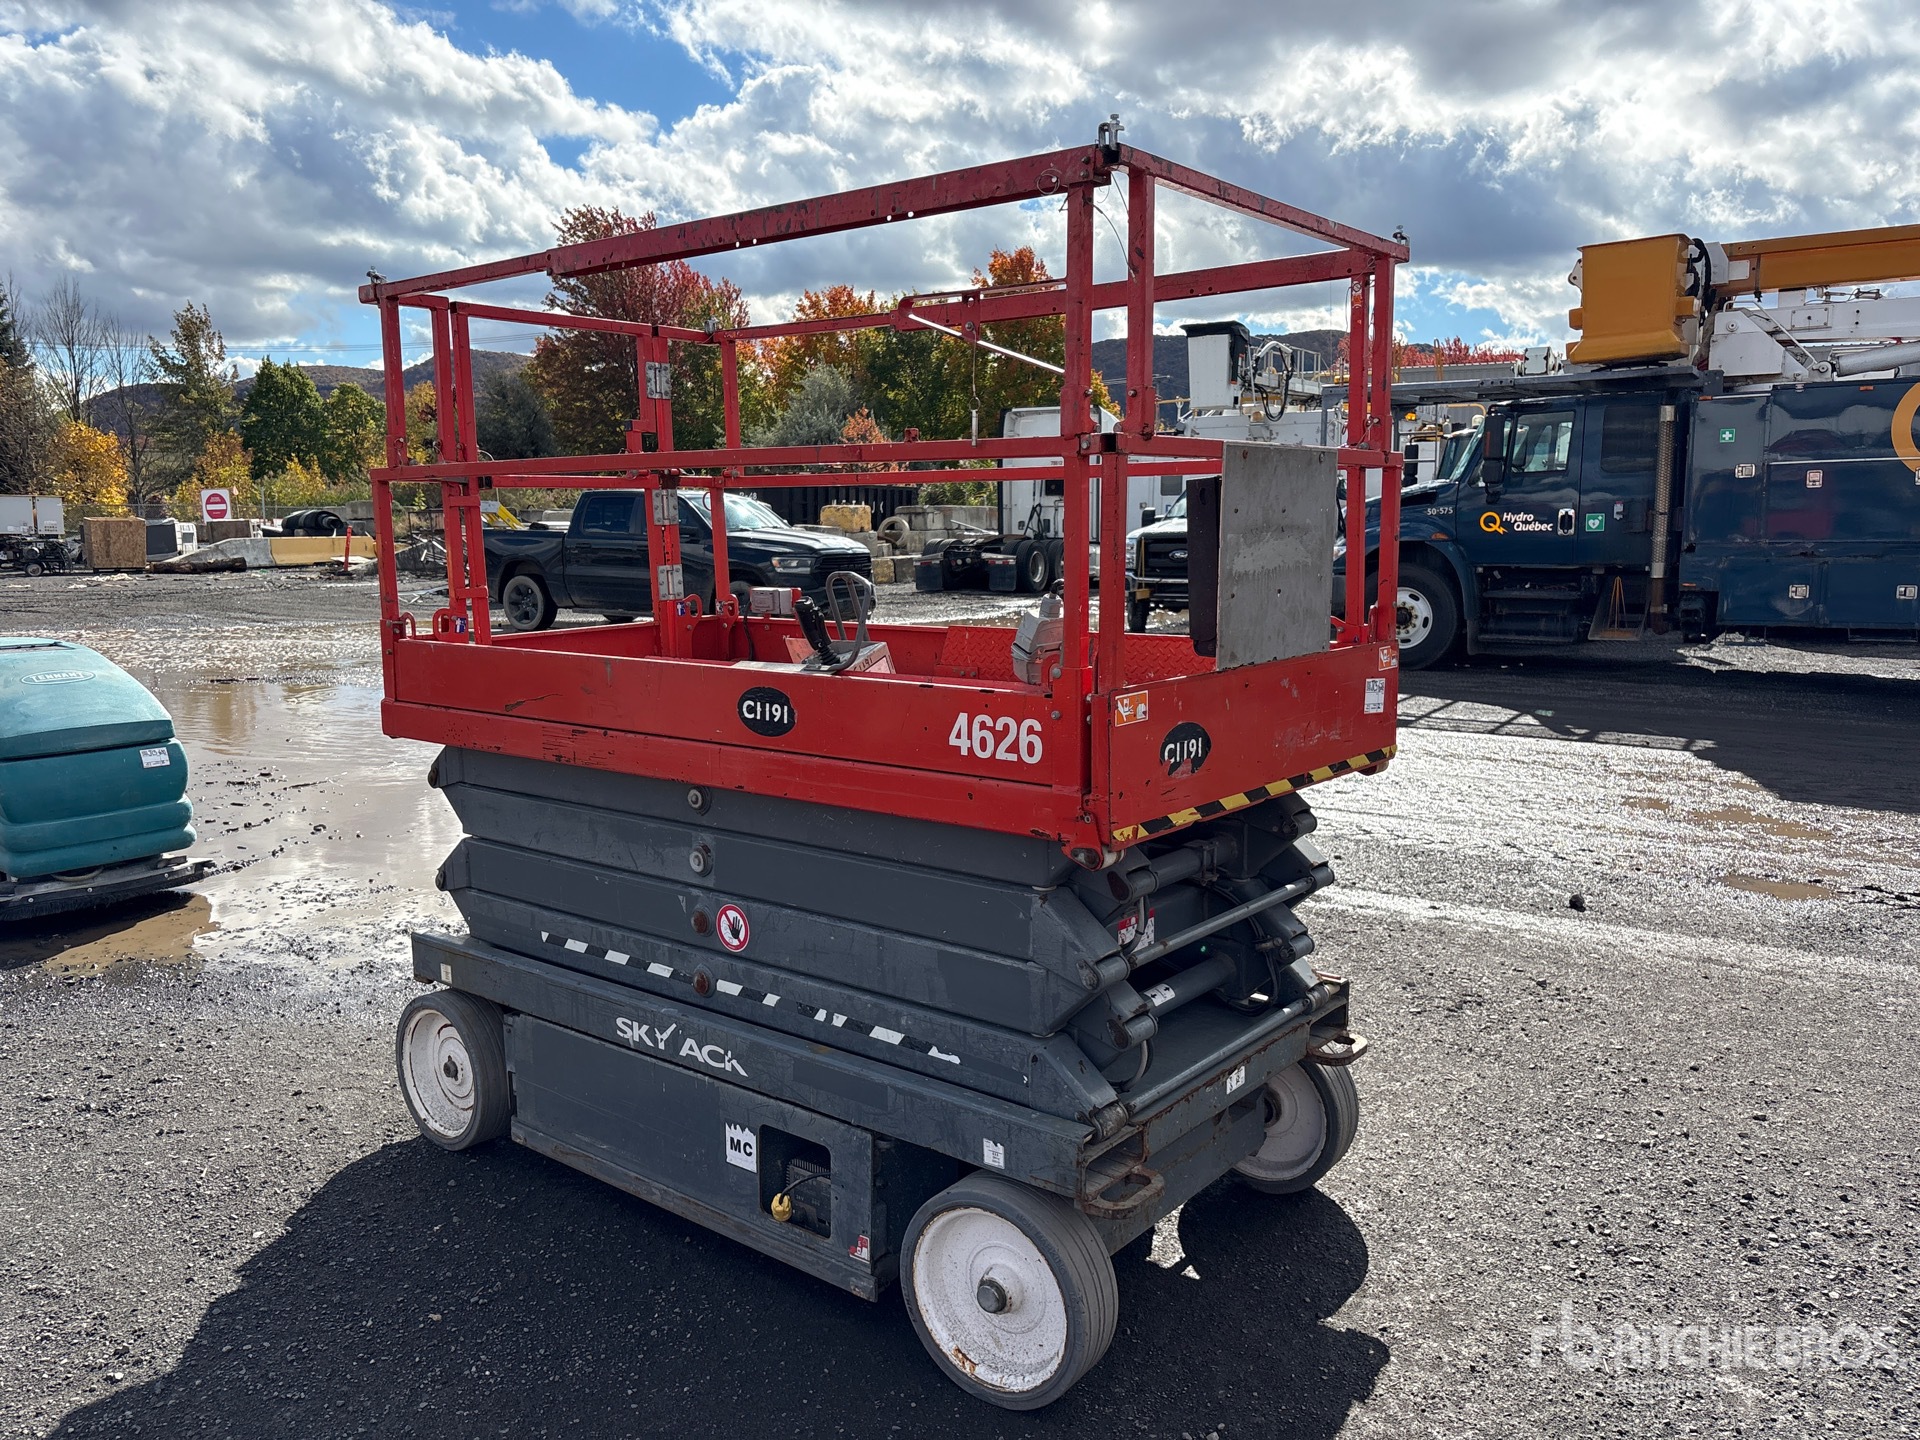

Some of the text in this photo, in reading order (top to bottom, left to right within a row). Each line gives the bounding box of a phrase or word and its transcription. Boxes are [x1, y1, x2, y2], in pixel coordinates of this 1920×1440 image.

[1427, 506, 1453, 516] 50-575
[1503, 511, 1534, 523] Hydro
[1514, 520, 1553, 532] Québec
[30, 671, 84, 683] TENNANT
[949, 712, 1043, 764] 4626
[615, 1016, 749, 1078] SKYACK
[730, 1136, 753, 1157] MC
